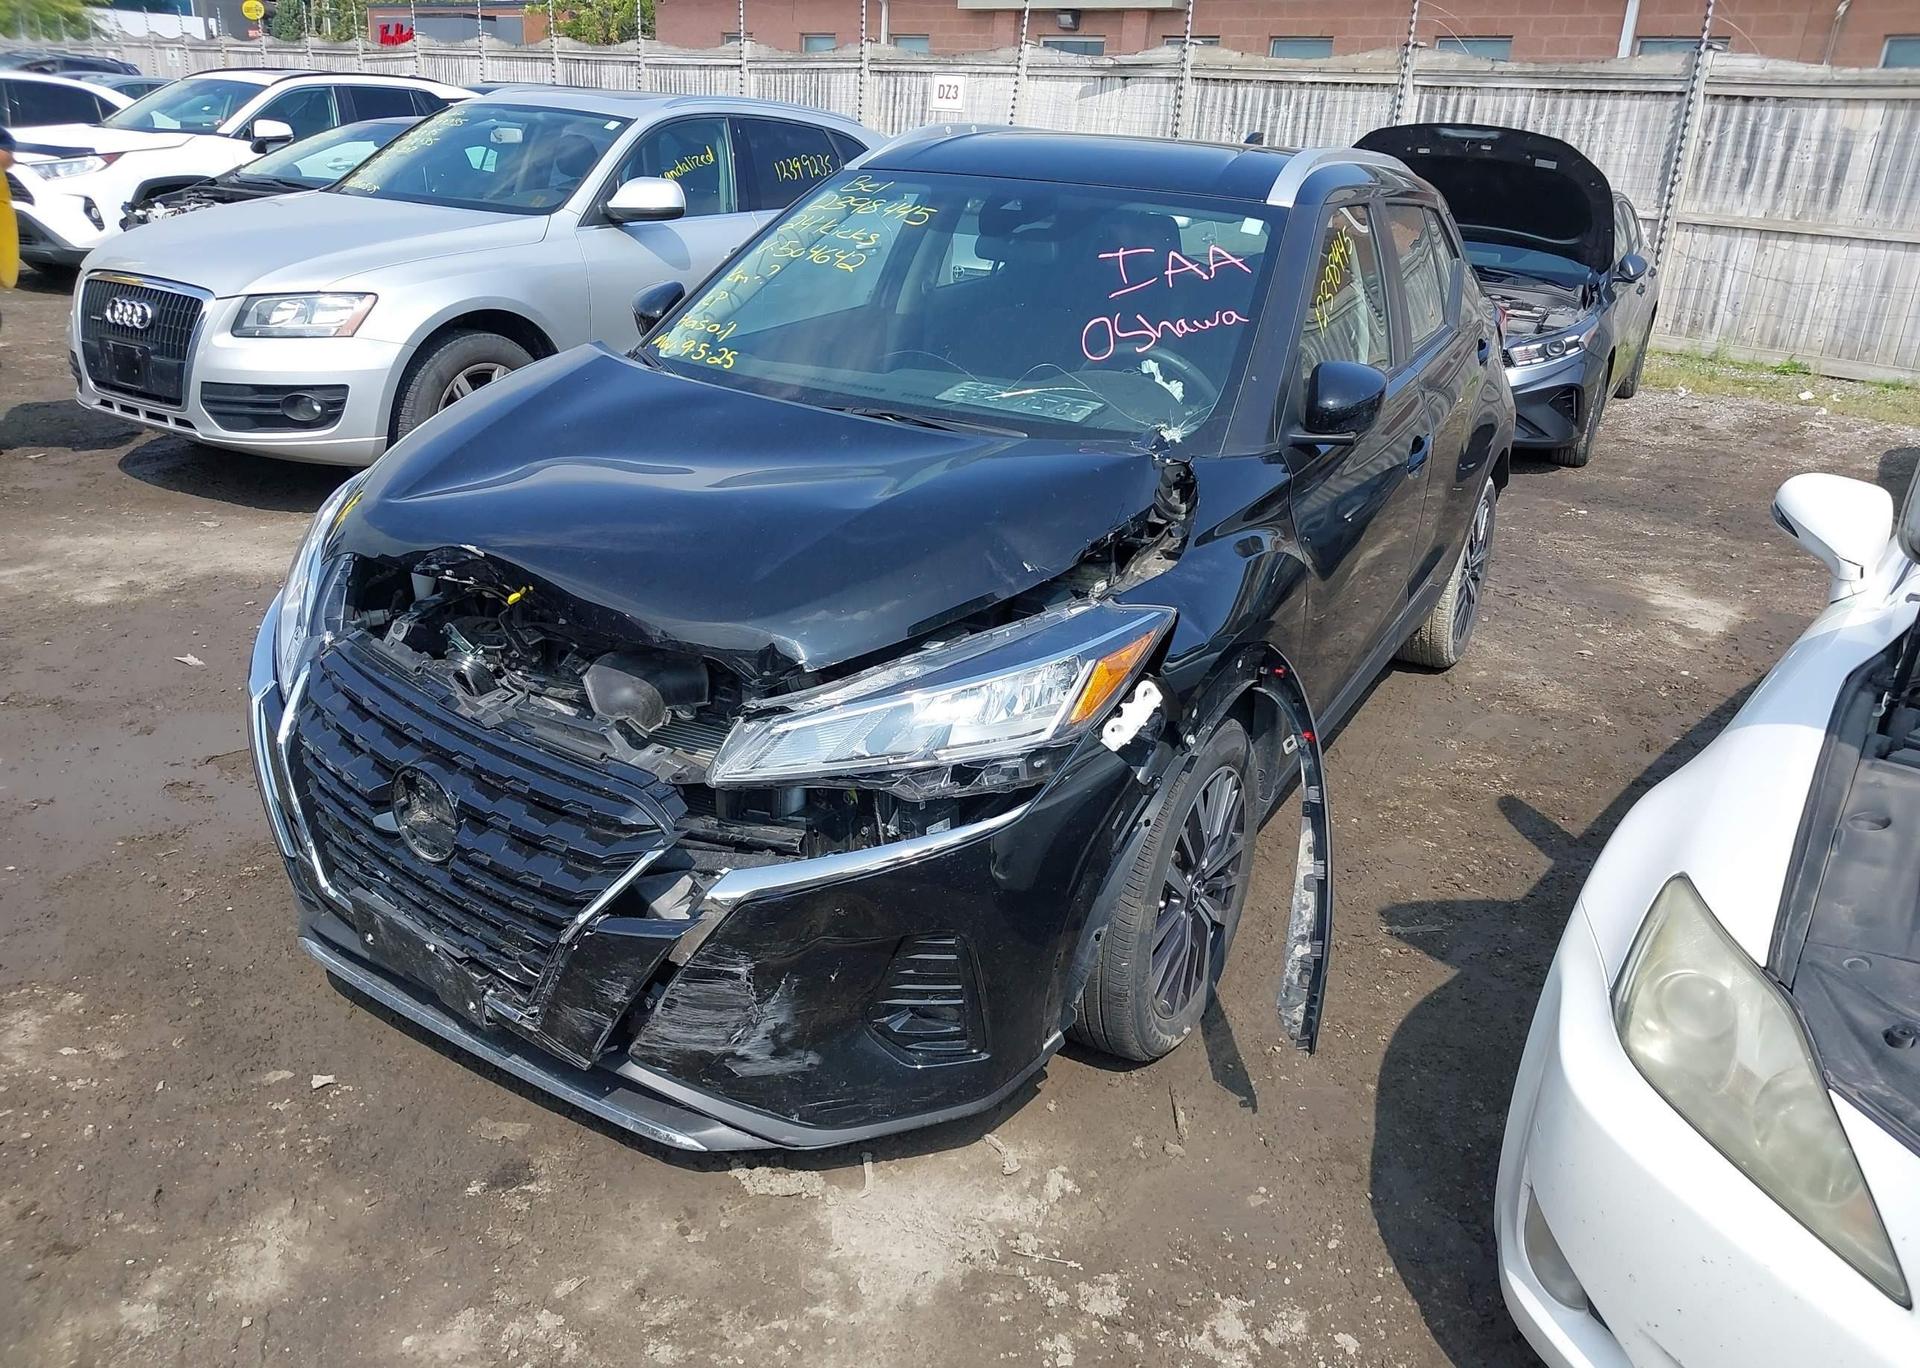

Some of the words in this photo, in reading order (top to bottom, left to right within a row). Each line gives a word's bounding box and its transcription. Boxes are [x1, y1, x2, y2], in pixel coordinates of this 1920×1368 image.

[938, 84, 959, 100] DZ3
[659, 145, 715, 181] andalized
[774, 153, 833, 183] 12399235
[1098, 244, 1253, 299] IAA
[1315, 224, 1353, 339] 12398445
